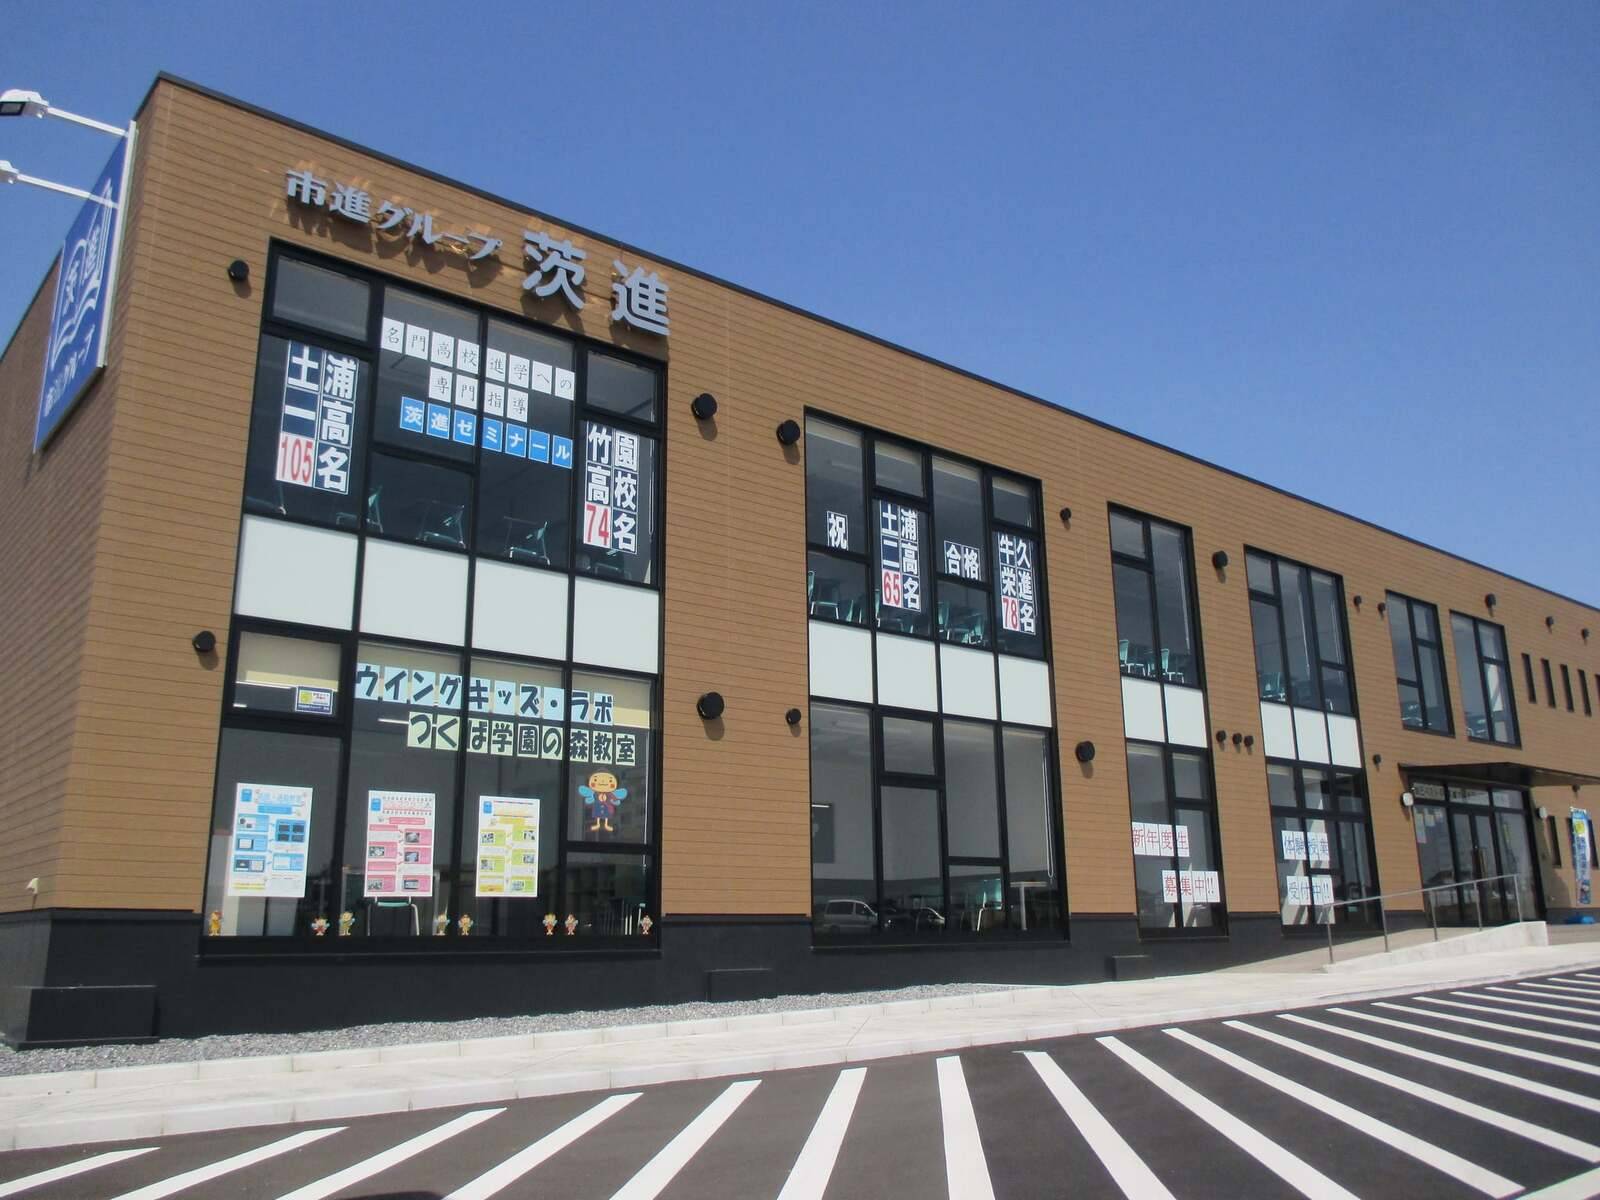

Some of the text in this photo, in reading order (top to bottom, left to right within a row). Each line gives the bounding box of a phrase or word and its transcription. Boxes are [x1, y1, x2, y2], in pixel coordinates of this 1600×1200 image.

[286, 169, 670, 336] 市進グループ 茨進
[287, 345, 358, 399] 土浦
[386, 324, 573, 391] 名門高校進学への
[434, 376, 528, 416] 専門指導
[283, 401, 354, 445] 一高
[403, 404, 571, 460] 茨進ゼミナール
[279, 435, 349, 492] 105名
[588, 425, 639, 469] 竹園
[587, 467, 638, 510] 高校
[586, 508, 637, 552] 74名
[829, 514, 847, 549] 祝
[882, 508, 918, 542] 土浦
[883, 540, 918, 575] 二高
[946, 545, 979, 580] 合格
[1000, 535, 1031, 568] 牛久
[883, 572, 920, 609] 65名
[1001, 566, 1032, 600] 栄進
[1003, 598, 1035, 633] 78名
[356, 665, 614, 724] ウイングキッズ・ラボ
[410, 714, 636, 763] つくば学園の森教室
